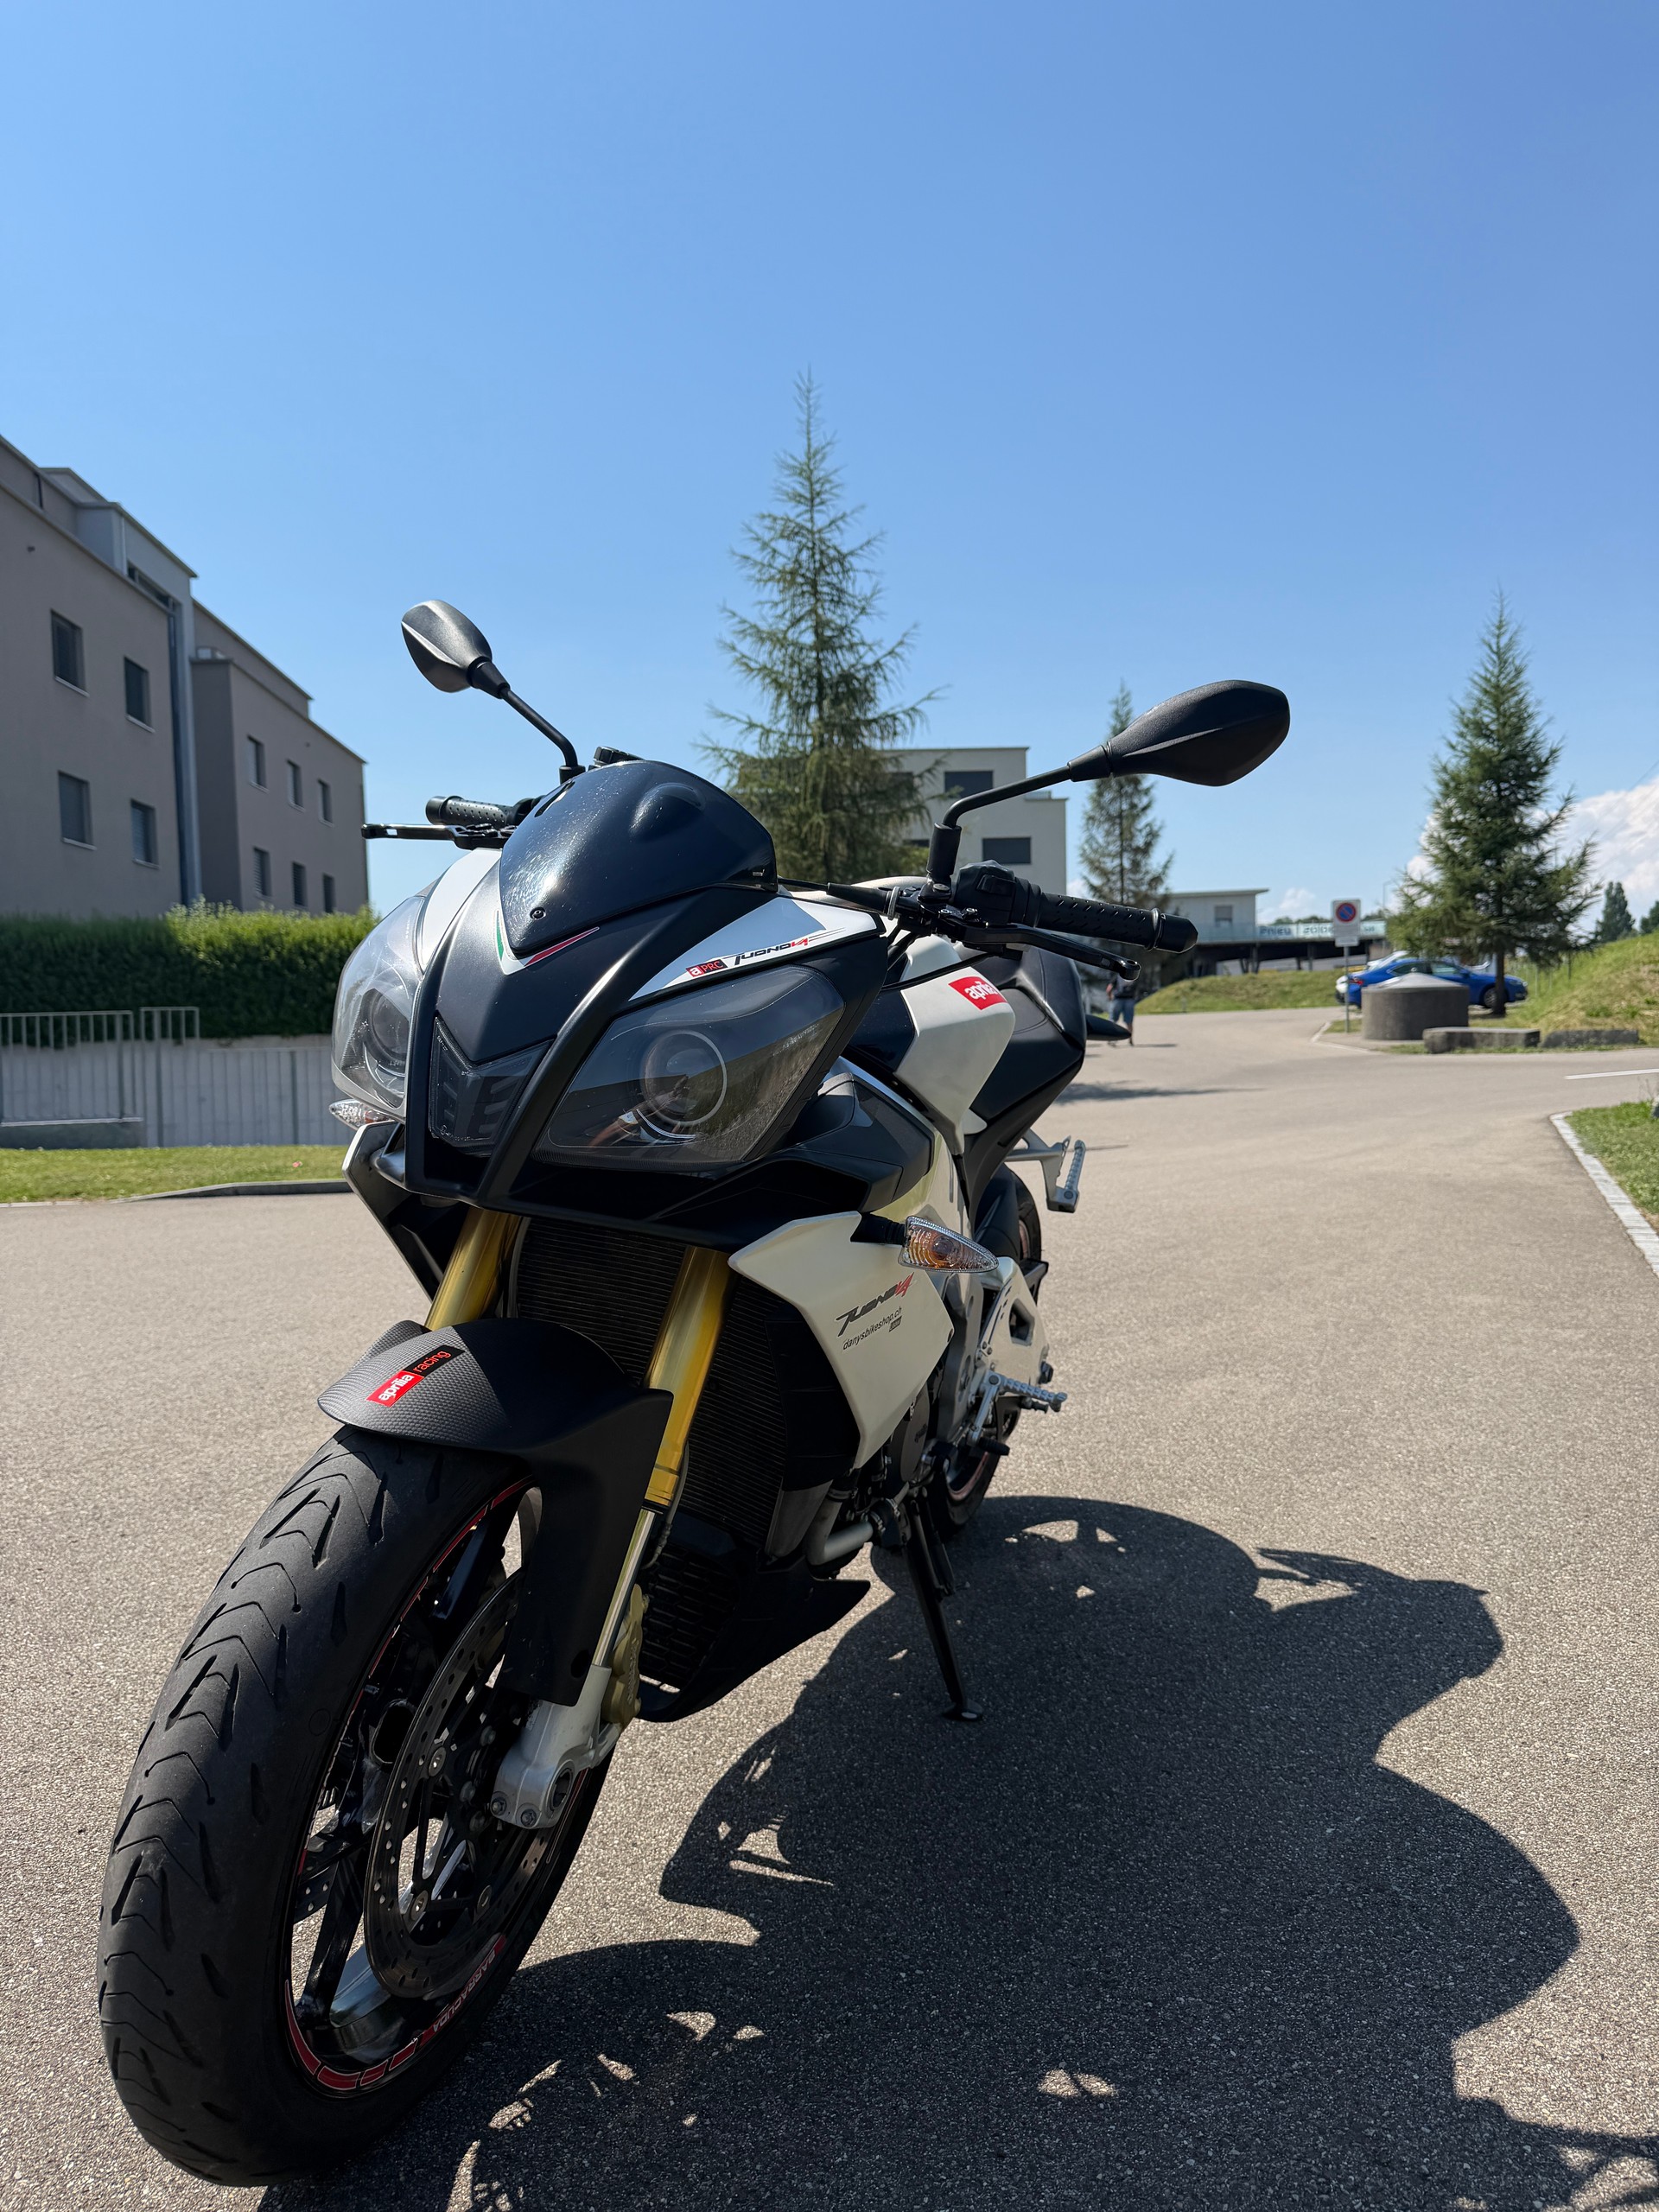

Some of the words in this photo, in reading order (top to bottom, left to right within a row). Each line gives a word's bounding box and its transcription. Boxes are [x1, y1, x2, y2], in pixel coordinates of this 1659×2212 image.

[842, 1306, 902, 1350] danysbikeshop.ch
[378, 1374, 415, 1401] aprilia
[413, 1351, 452, 1372] racing
[433, 1950, 496, 2032] BARRACUDA
